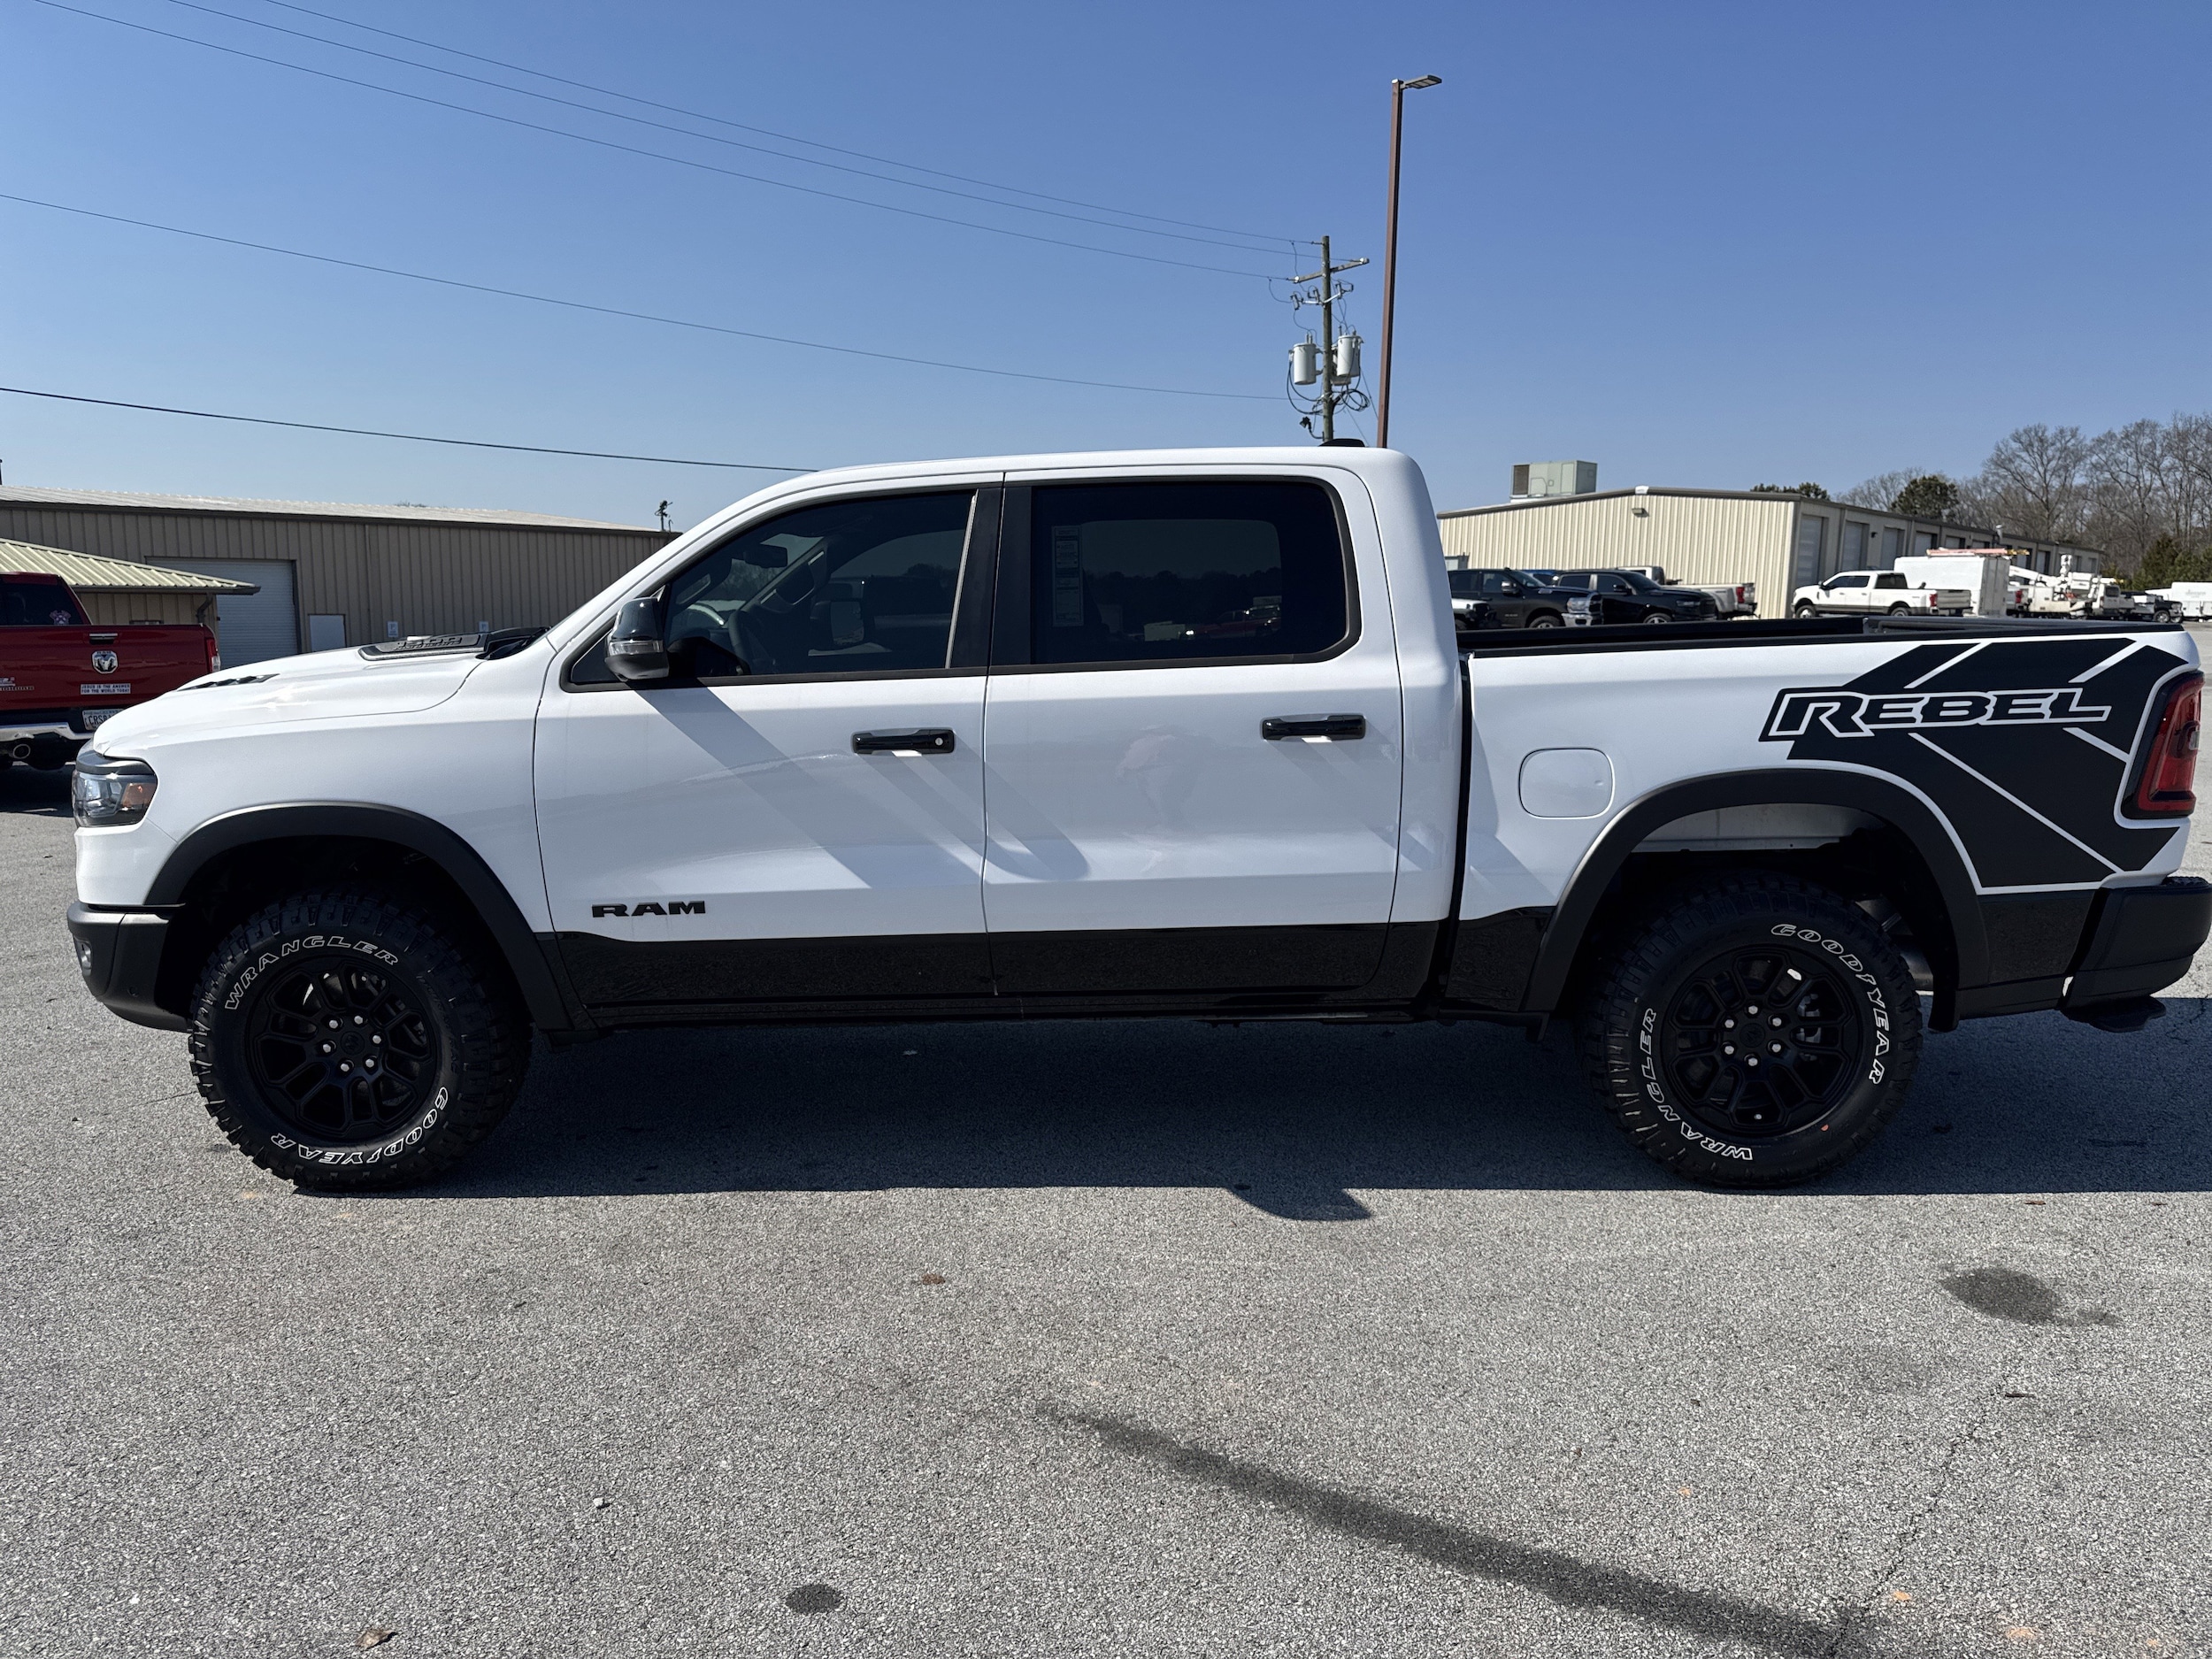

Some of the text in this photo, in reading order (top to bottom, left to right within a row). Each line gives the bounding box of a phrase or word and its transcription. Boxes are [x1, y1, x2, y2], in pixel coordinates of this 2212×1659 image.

[1768, 687, 2112, 738] REBEL
[591, 900, 706, 918] RAM
[225, 935, 398, 1010] WRANGLER
[1770, 923, 1890, 1085] GOODYEAR
[1640, 1008, 1754, 1161] WRANGLER
[270, 1087, 449, 1165] GOODYEAR
